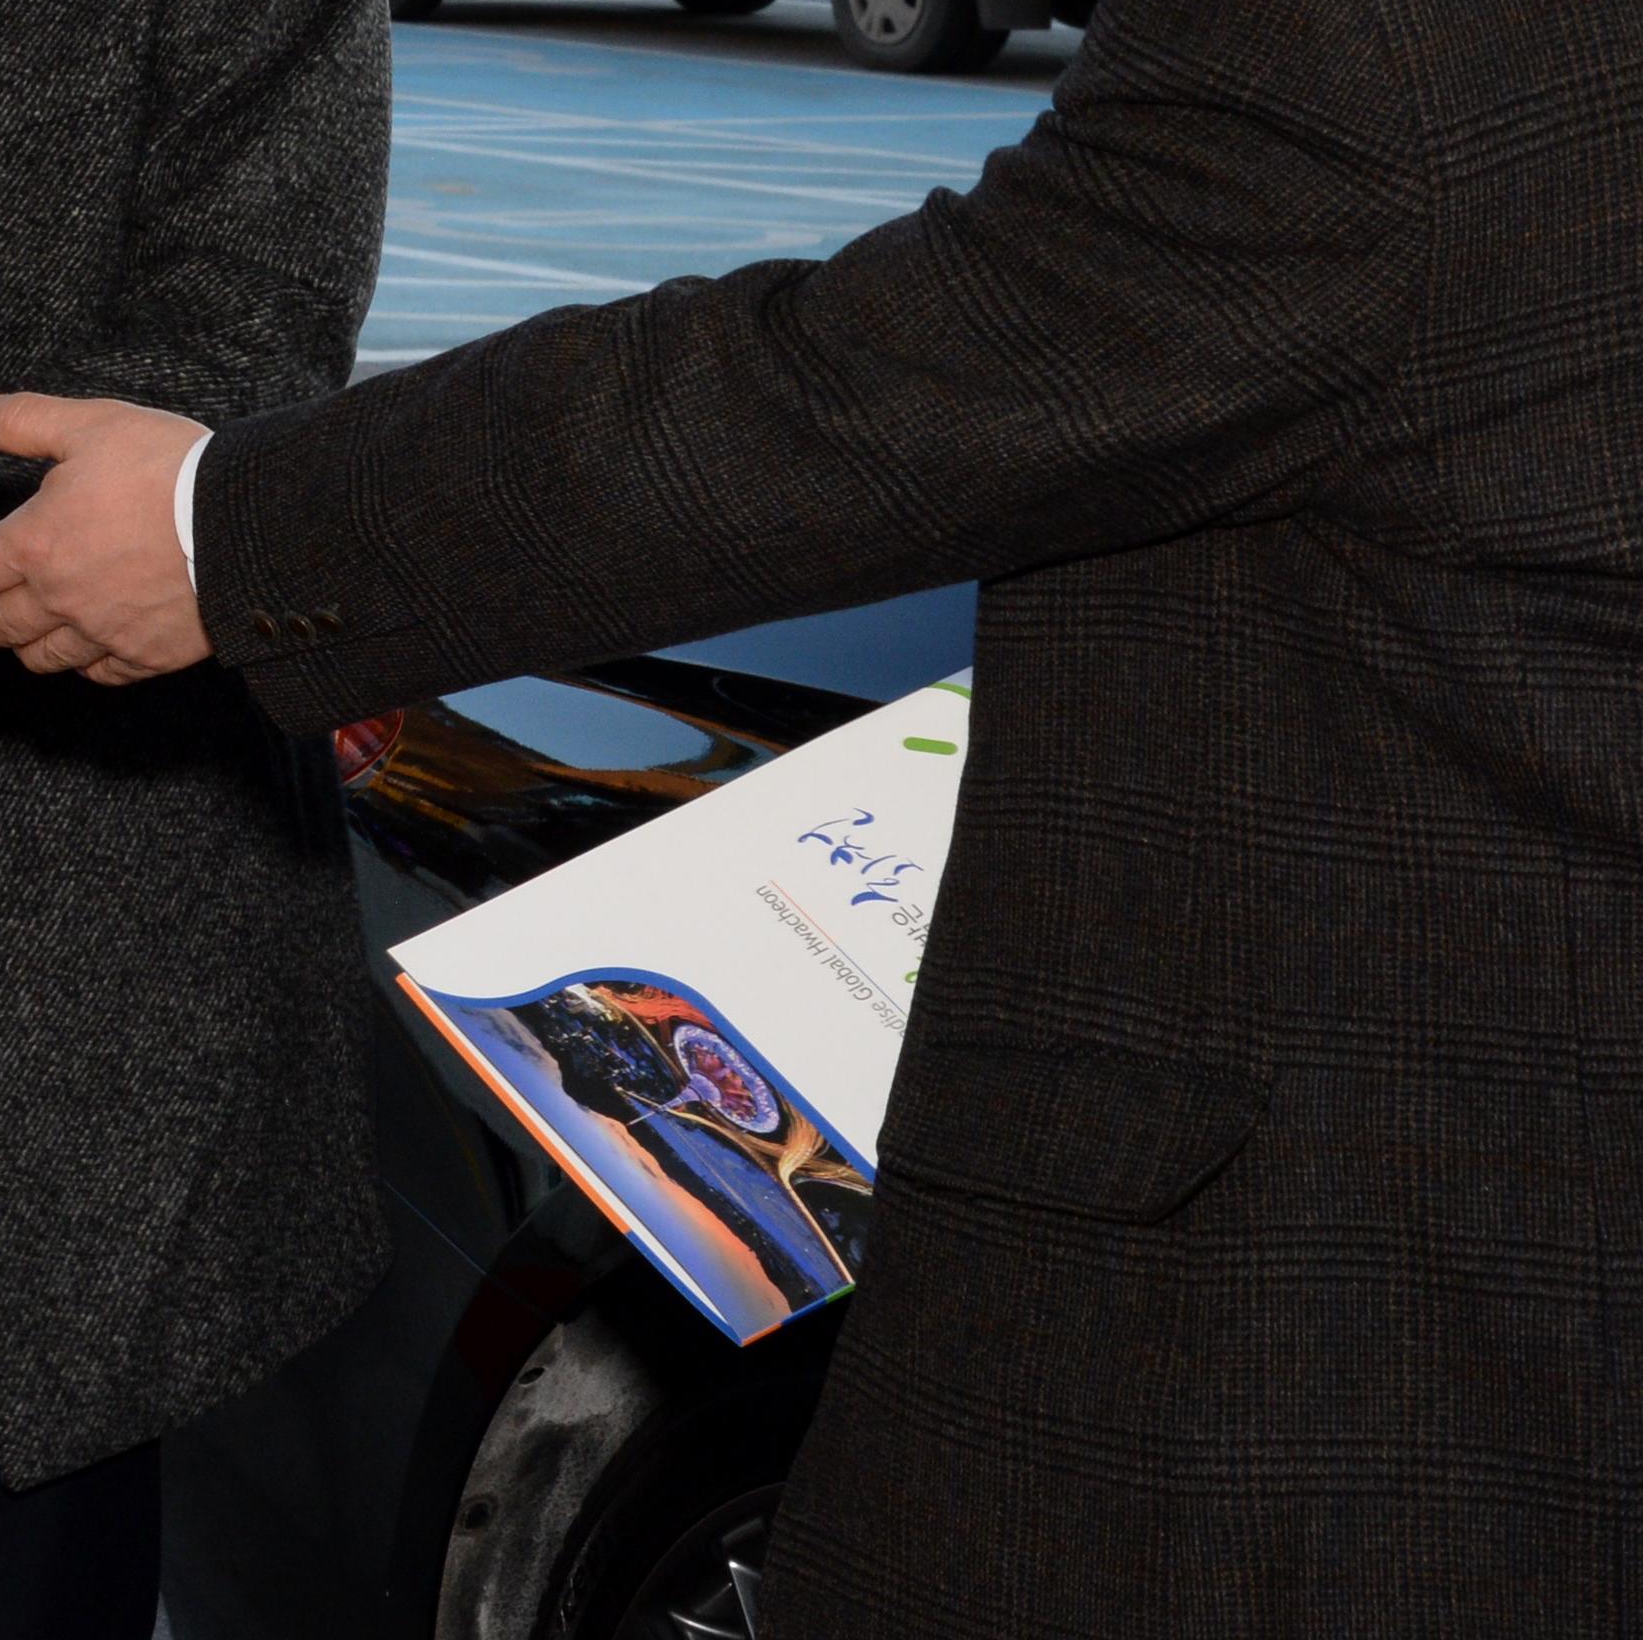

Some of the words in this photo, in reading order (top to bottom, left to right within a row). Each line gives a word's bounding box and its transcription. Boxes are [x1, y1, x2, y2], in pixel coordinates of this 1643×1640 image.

[798, 807, 924, 907] 화천
[755, 885, 829, 957] Hwacheon
[820, 953, 874, 1002] Global
